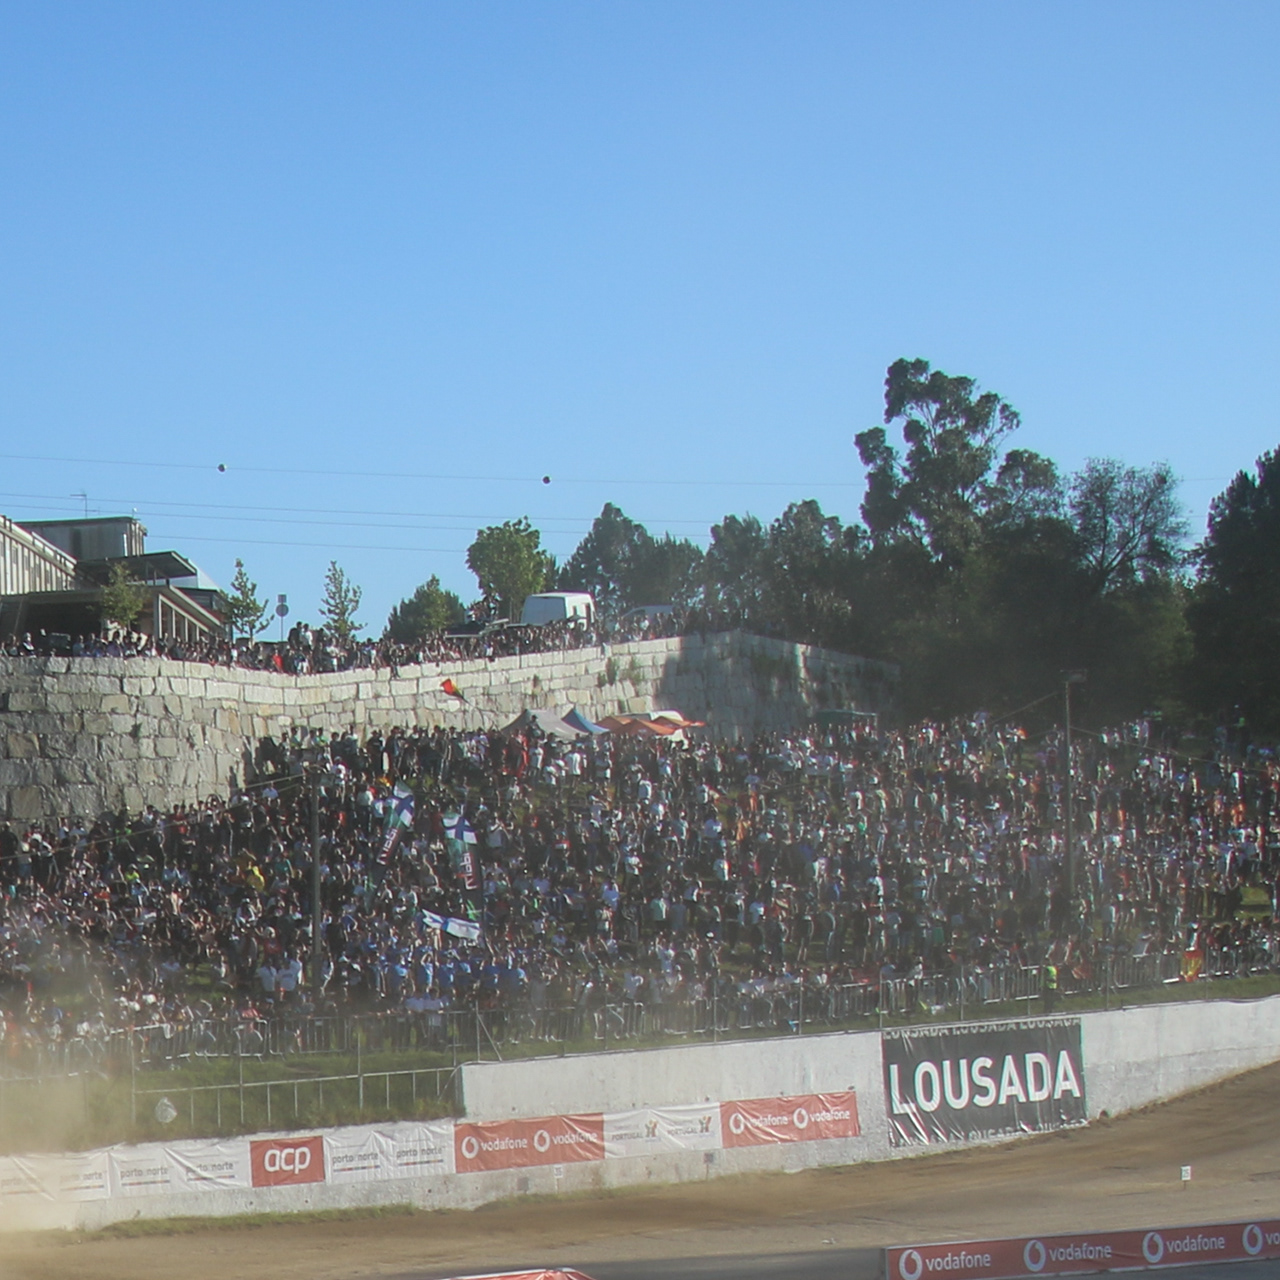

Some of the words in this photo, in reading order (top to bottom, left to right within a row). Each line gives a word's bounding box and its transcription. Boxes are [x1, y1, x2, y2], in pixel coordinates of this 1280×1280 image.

[889, 1050, 1081, 1115] LOUSADA
[809, 1108, 851, 1123] vodafone
[480, 1137, 528, 1152] vodafone
[553, 1130, 598, 1146] vodafone
[264, 1148, 311, 1175] acp
[925, 1252, 991, 1271] vodafone
[1049, 1243, 1112, 1262] vodafone
[1166, 1234, 1225, 1254] vodafone
